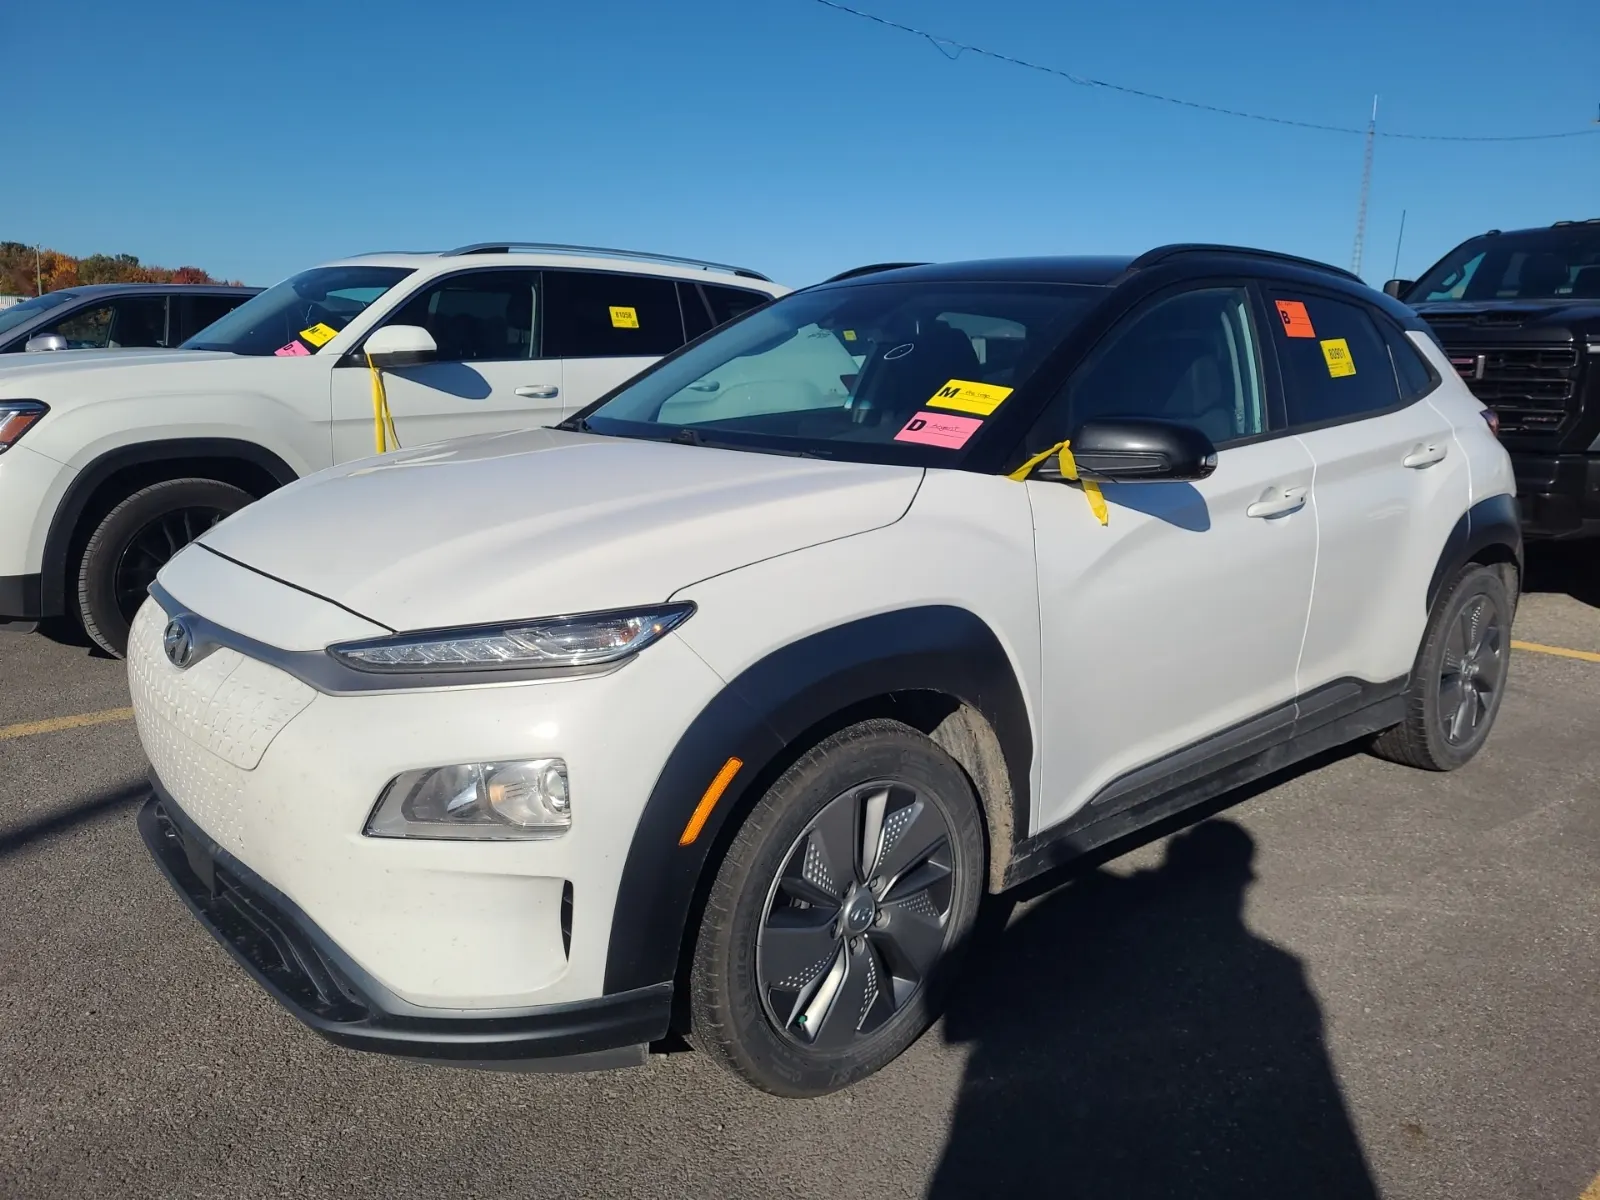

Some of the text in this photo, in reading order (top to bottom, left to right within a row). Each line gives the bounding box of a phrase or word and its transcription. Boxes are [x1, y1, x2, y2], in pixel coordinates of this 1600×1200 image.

[1281, 310, 1291, 324] B
[938, 387, 961, 398] M
[906, 419, 927, 431] D
